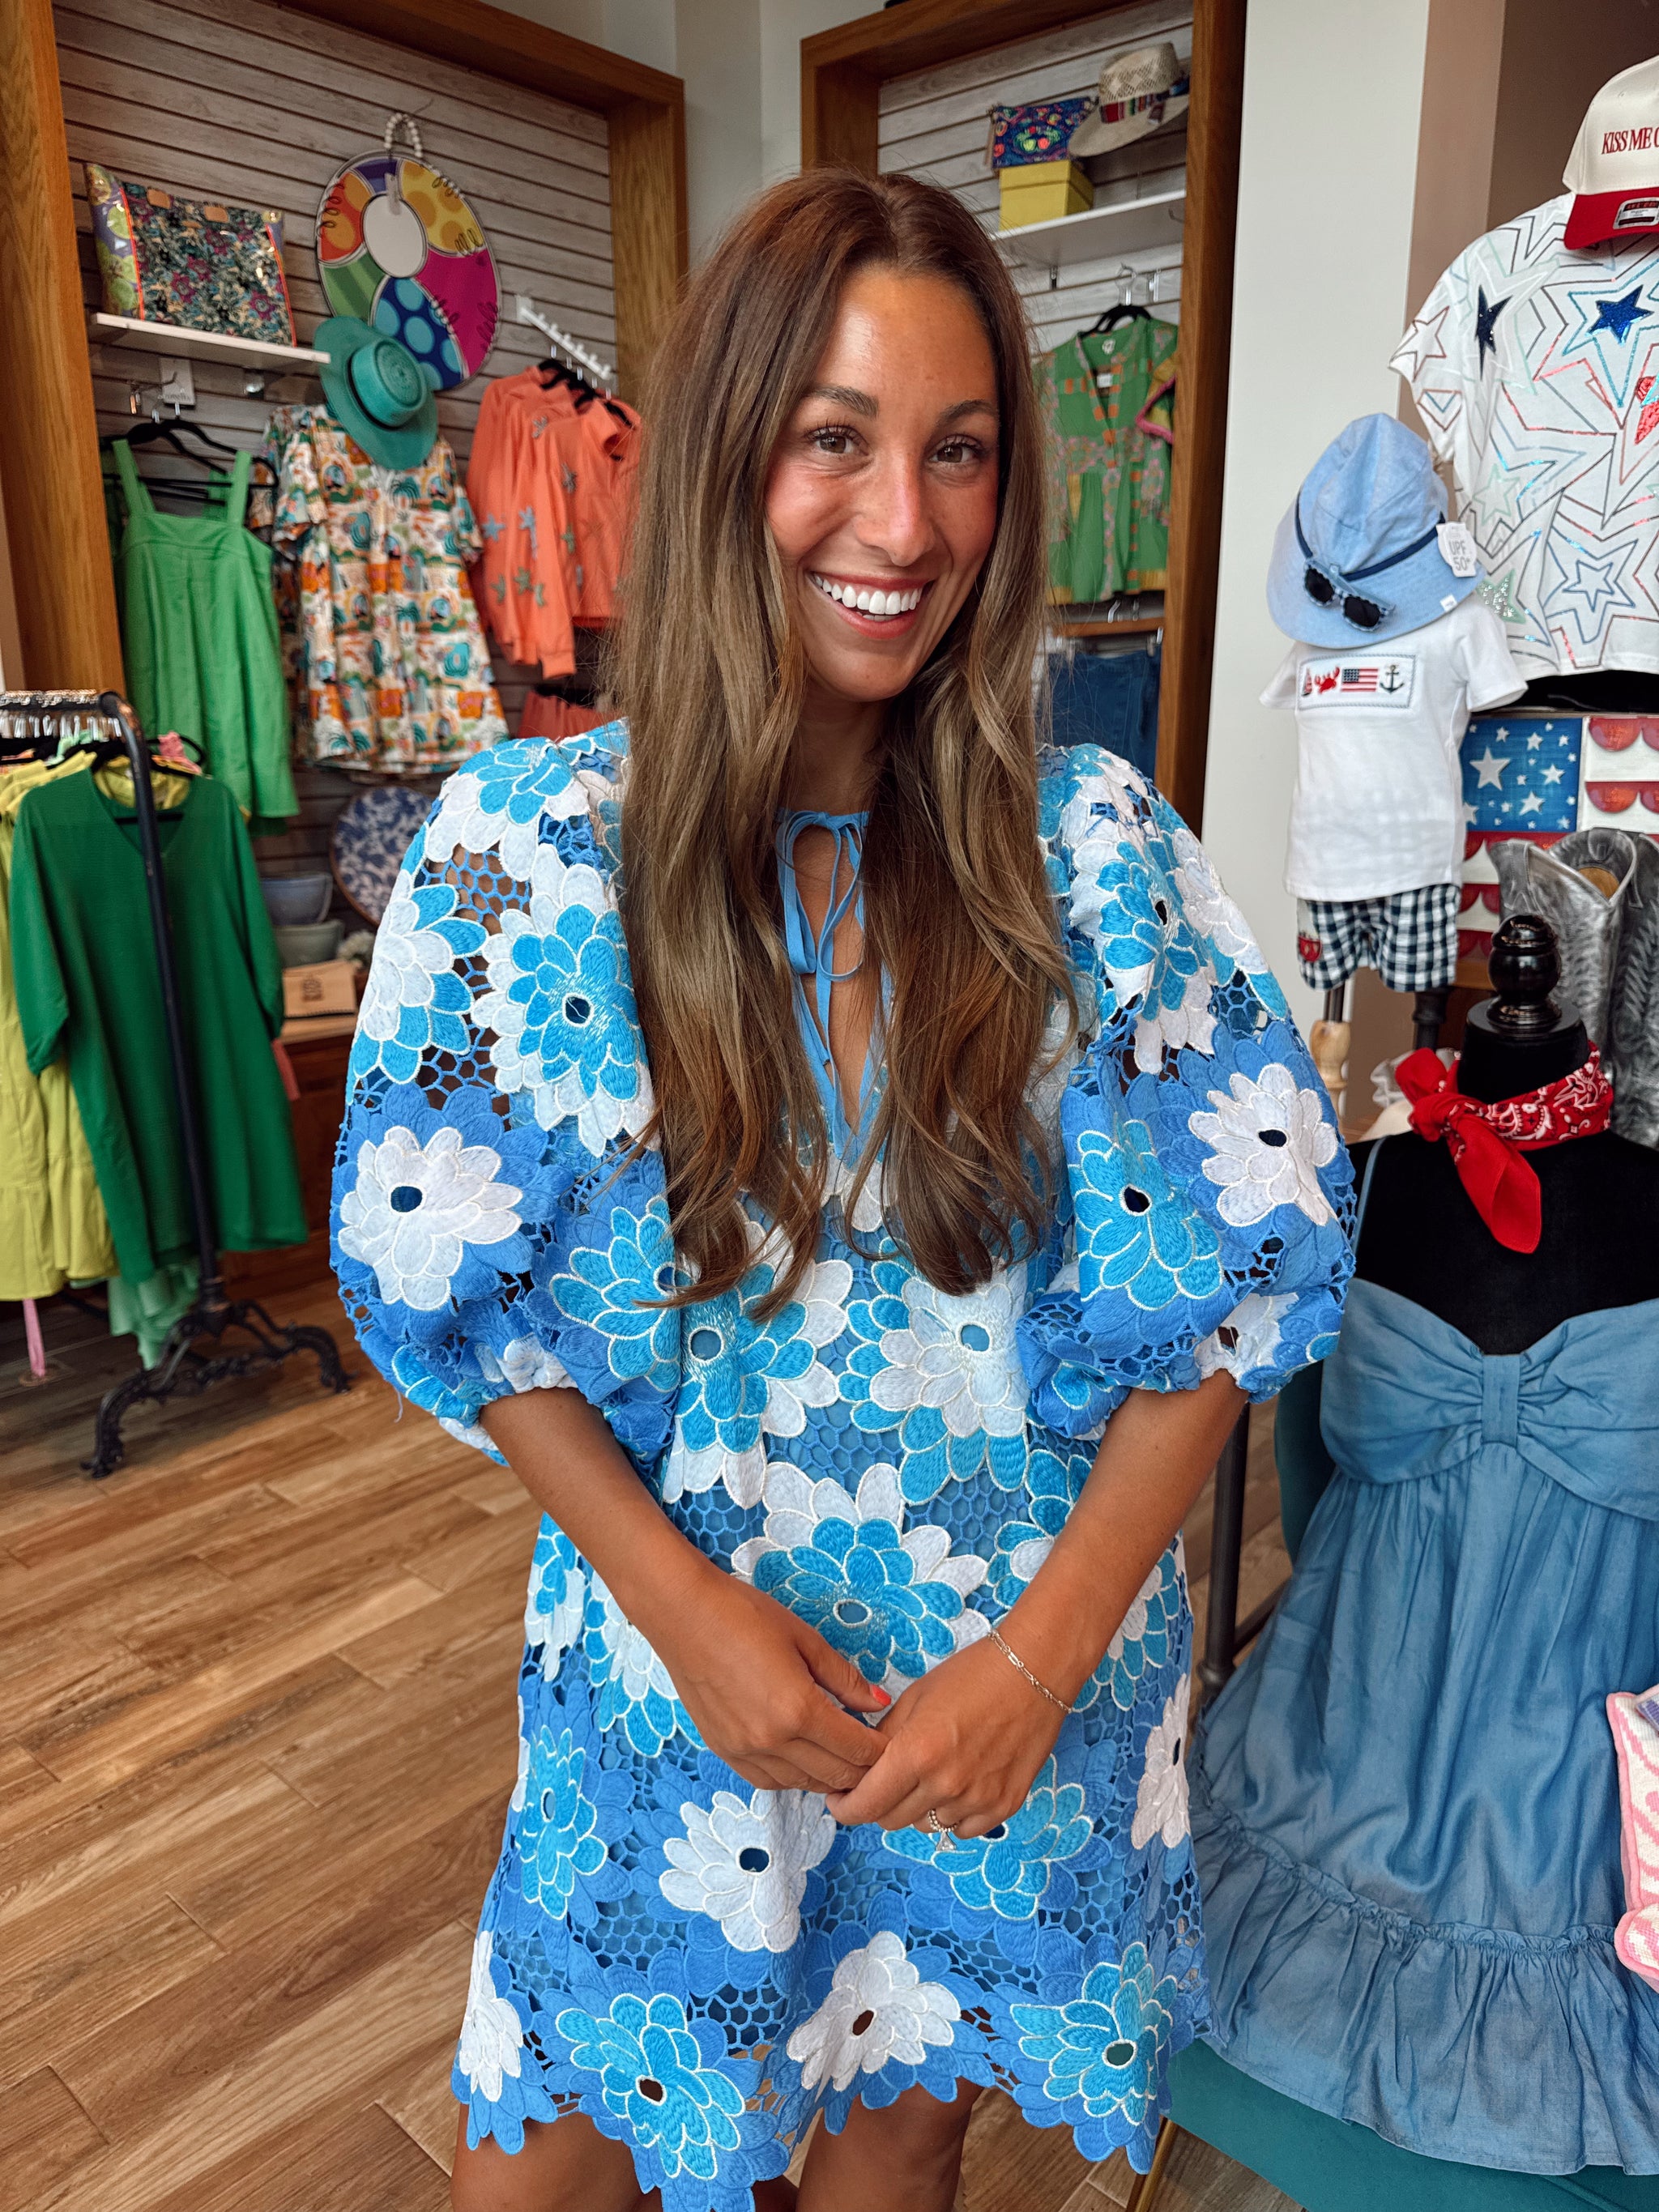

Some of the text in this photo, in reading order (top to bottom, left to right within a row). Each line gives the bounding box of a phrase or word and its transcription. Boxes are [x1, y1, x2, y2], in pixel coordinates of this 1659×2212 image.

[1601, 130, 1628, 155] KISS
[1628, 127, 1653, 151] ME
[1449, 539, 1466, 556] UPF
